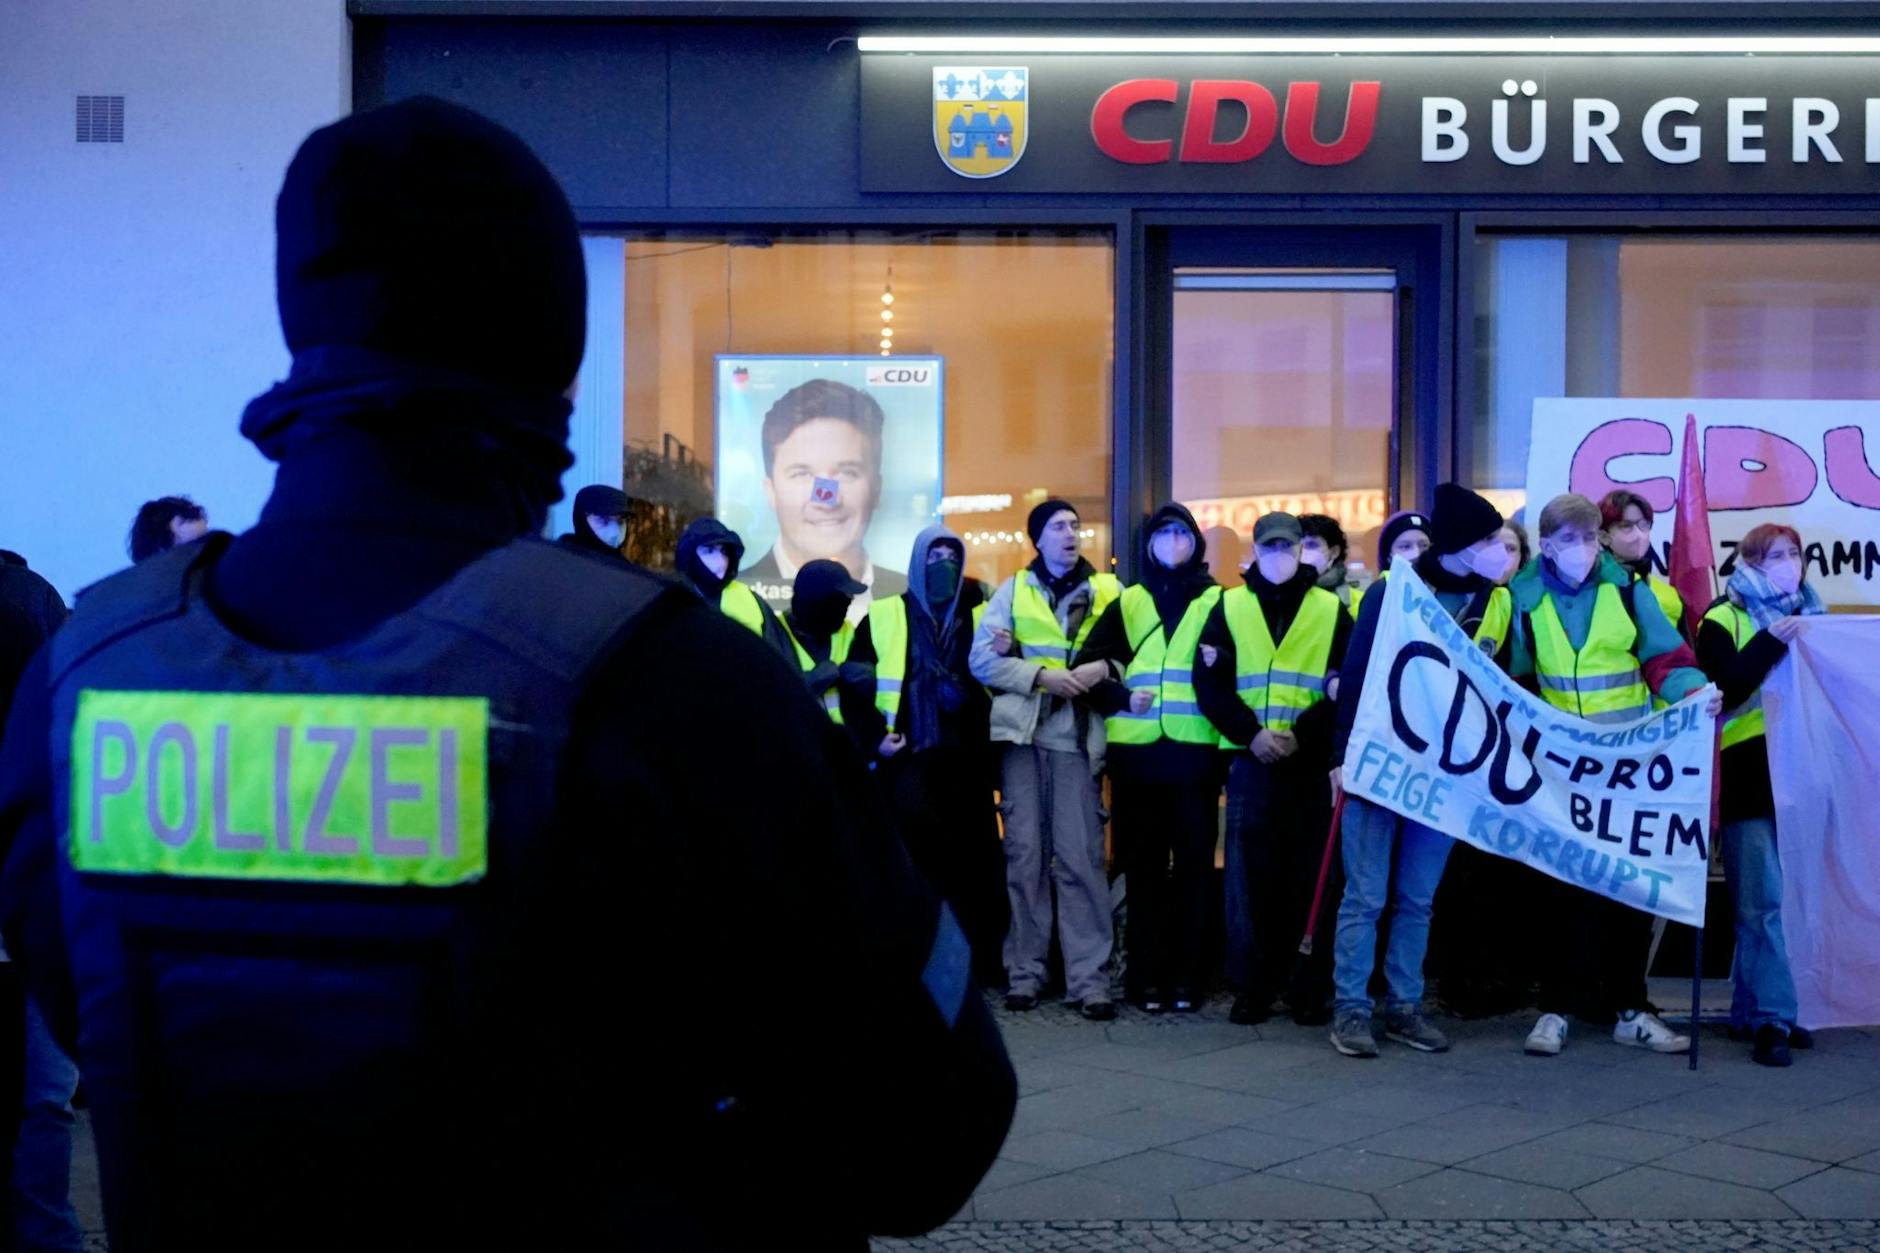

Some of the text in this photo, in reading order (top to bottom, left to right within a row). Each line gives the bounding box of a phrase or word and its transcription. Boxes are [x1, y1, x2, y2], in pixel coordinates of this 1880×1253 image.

[1091, 79, 1880, 166] CDU BÜRGER
[884, 369, 928, 384] CDU
[752, 581, 794, 600] kas
[90, 720, 458, 858] POLIZEI
[1353, 740, 1453, 823] FEIGE
[1467, 804, 1674, 909] KORRUPT
[1569, 792, 1707, 861] BLEM
